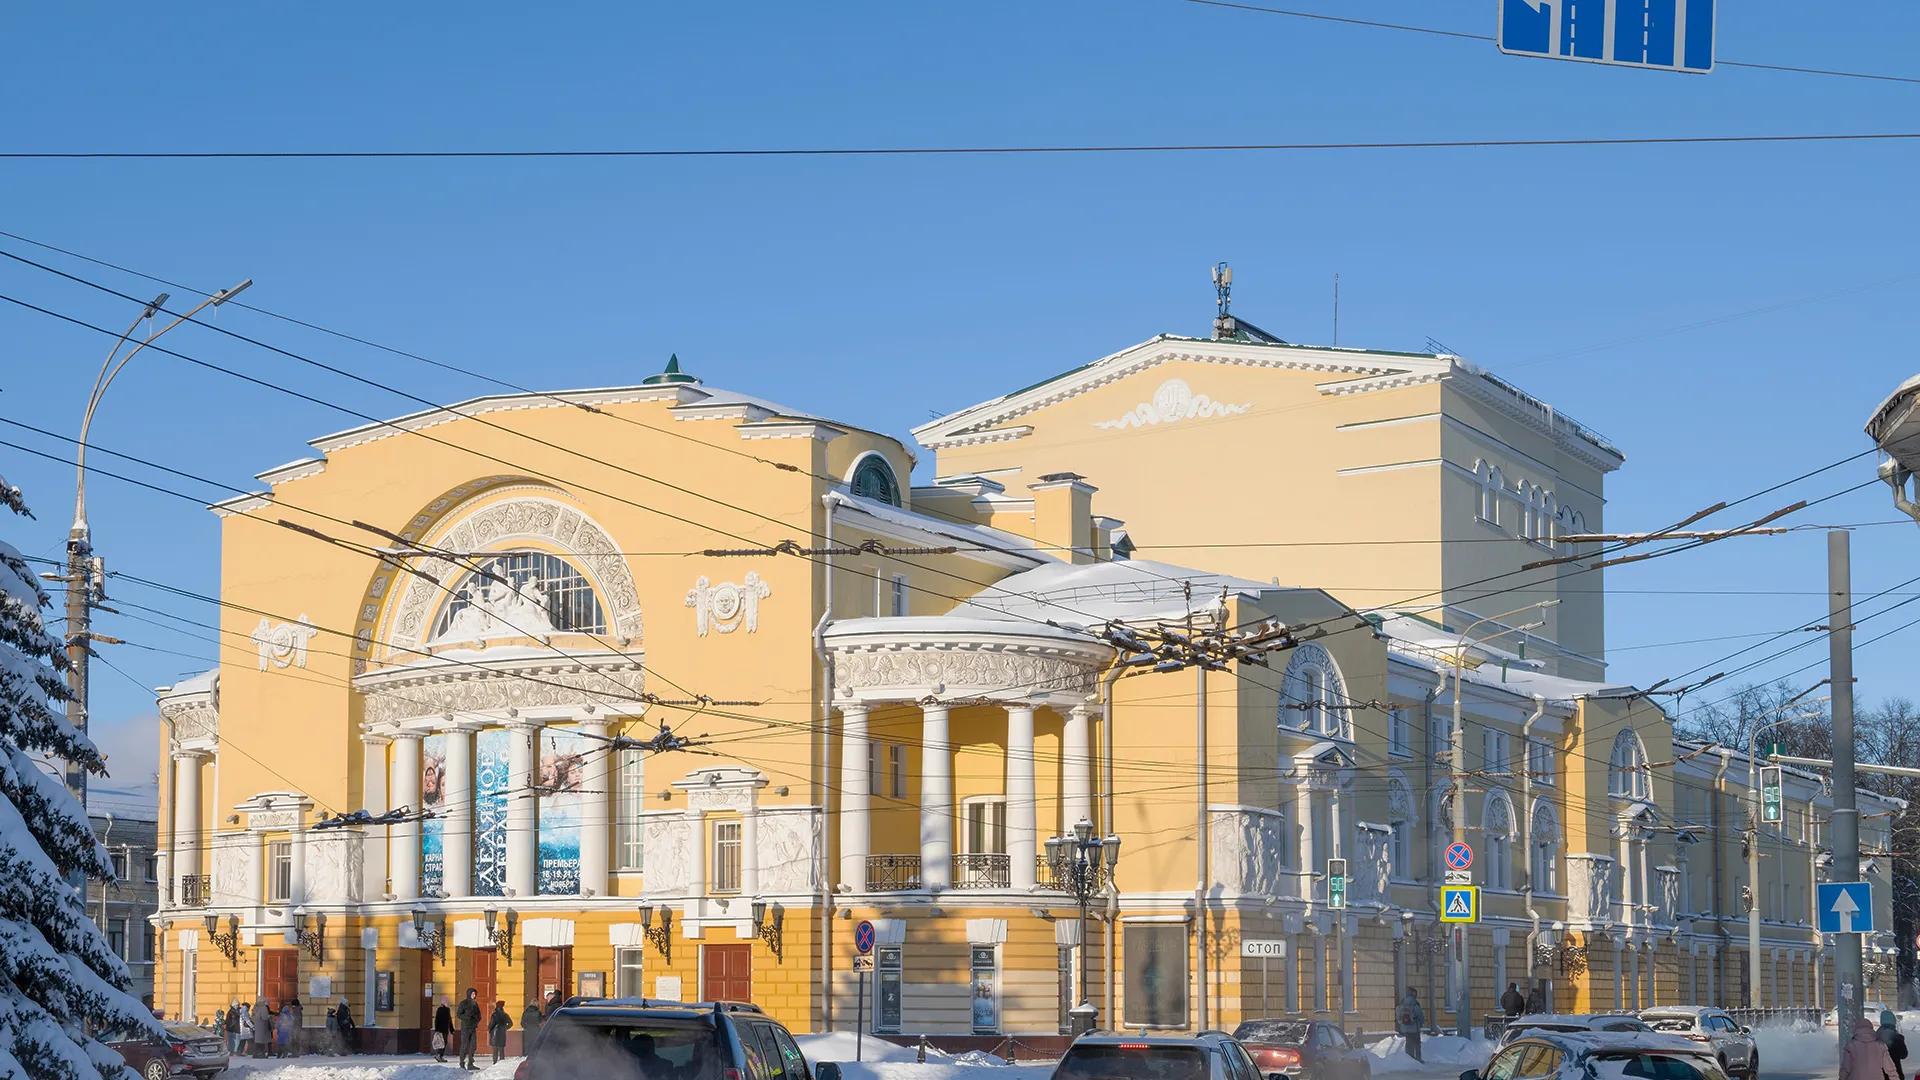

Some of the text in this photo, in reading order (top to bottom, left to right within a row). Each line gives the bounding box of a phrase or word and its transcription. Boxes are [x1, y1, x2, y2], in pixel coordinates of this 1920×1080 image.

[479, 751, 497, 888] ЛЕДЯНОЕ
[1331, 877, 1344, 892] 50
[1247, 943, 1281, 954] СТОП
